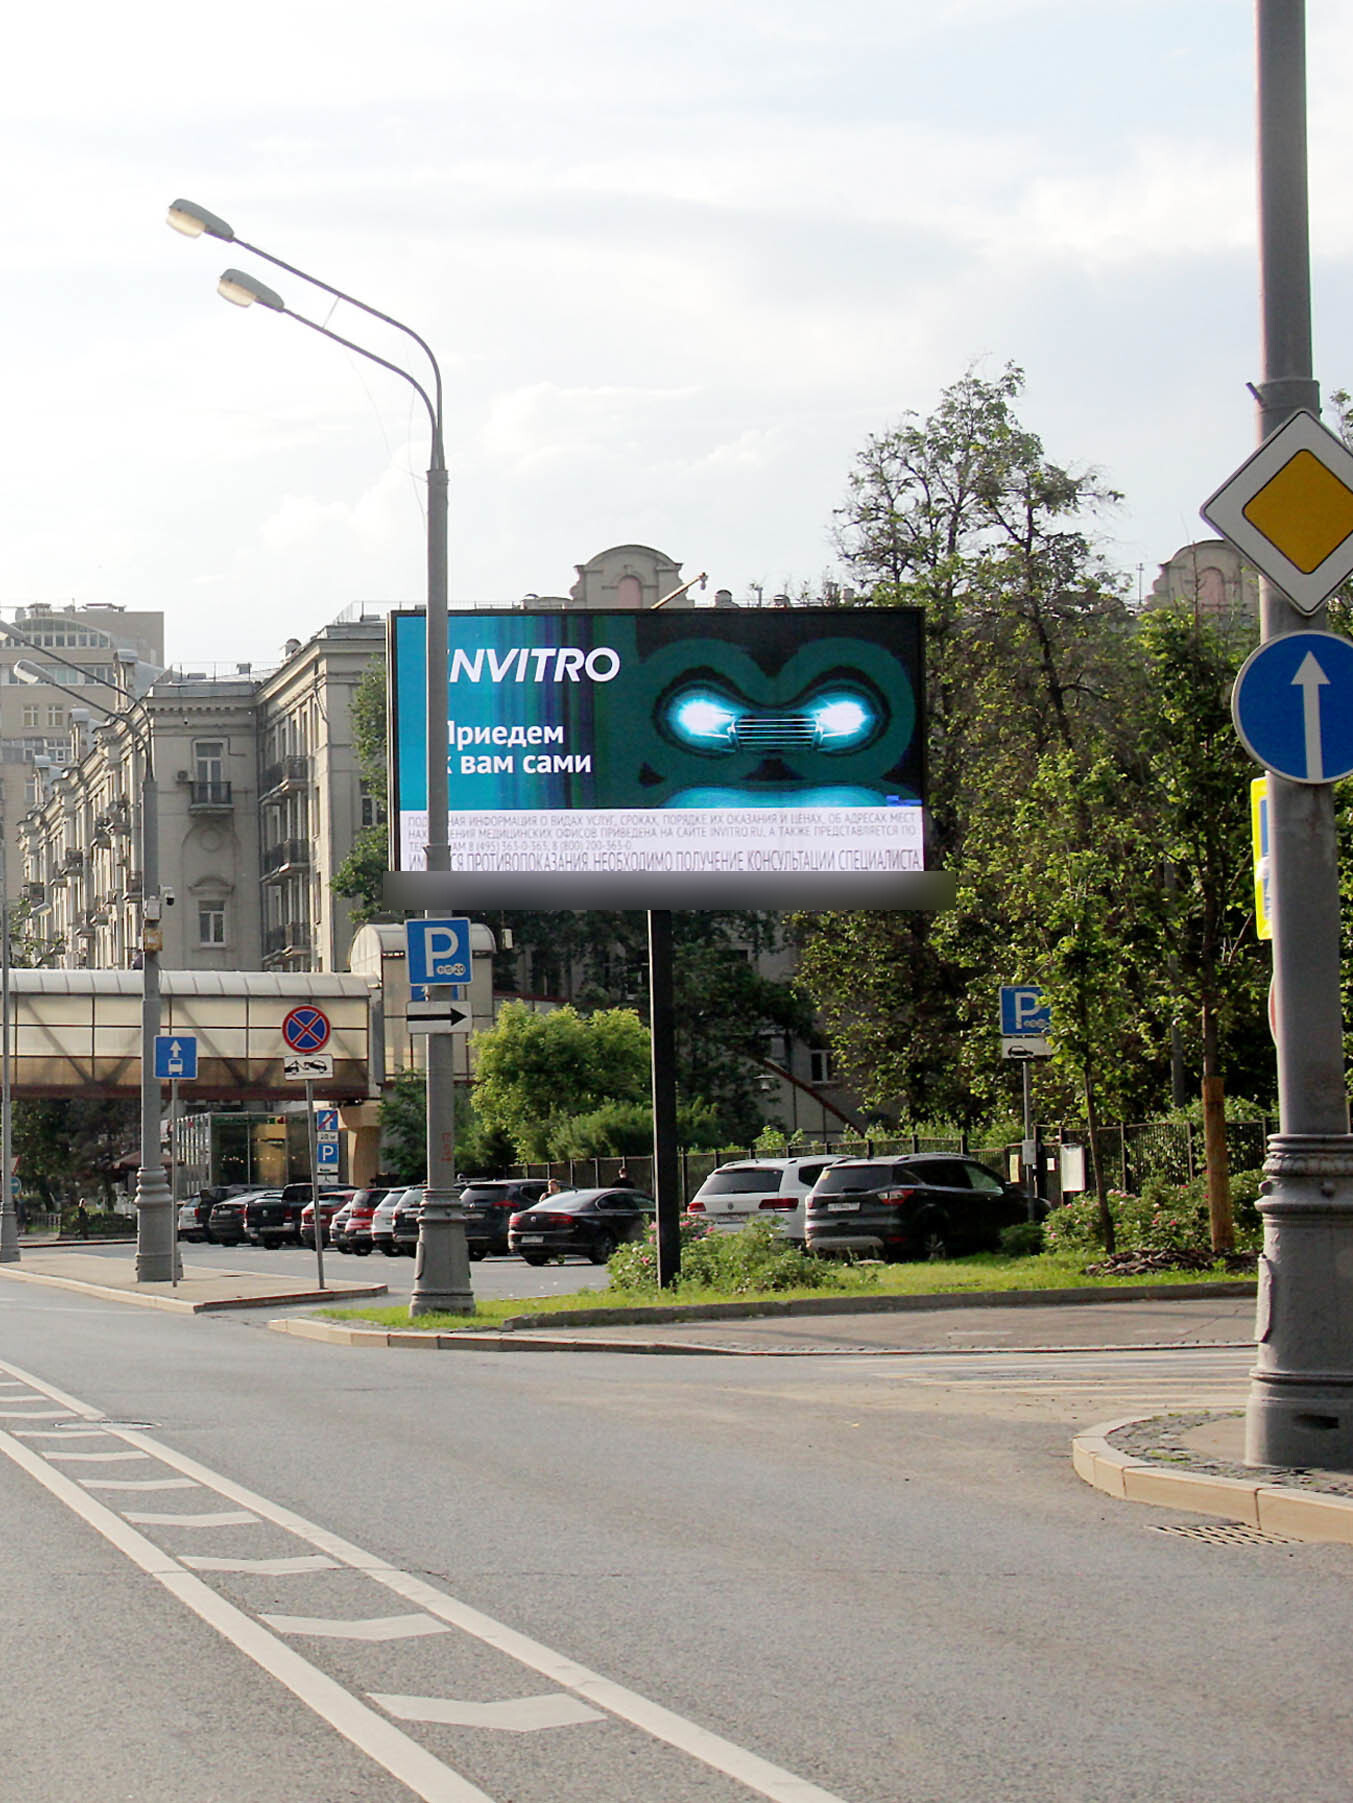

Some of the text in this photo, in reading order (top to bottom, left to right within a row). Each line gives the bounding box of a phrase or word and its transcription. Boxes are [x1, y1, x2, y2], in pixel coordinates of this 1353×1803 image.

[447, 647, 620, 683] NVITRO
[461, 756, 514, 775] вам
[522, 755, 591, 775] сами
[594, 851, 672, 871] НЕОБХОДИМО
[676, 850, 743, 870] ПОЛУЧЕНИЕ
[747, 849, 835, 870] КОНСУЛЬТАЦИИ
[424, 926, 459, 977] P
